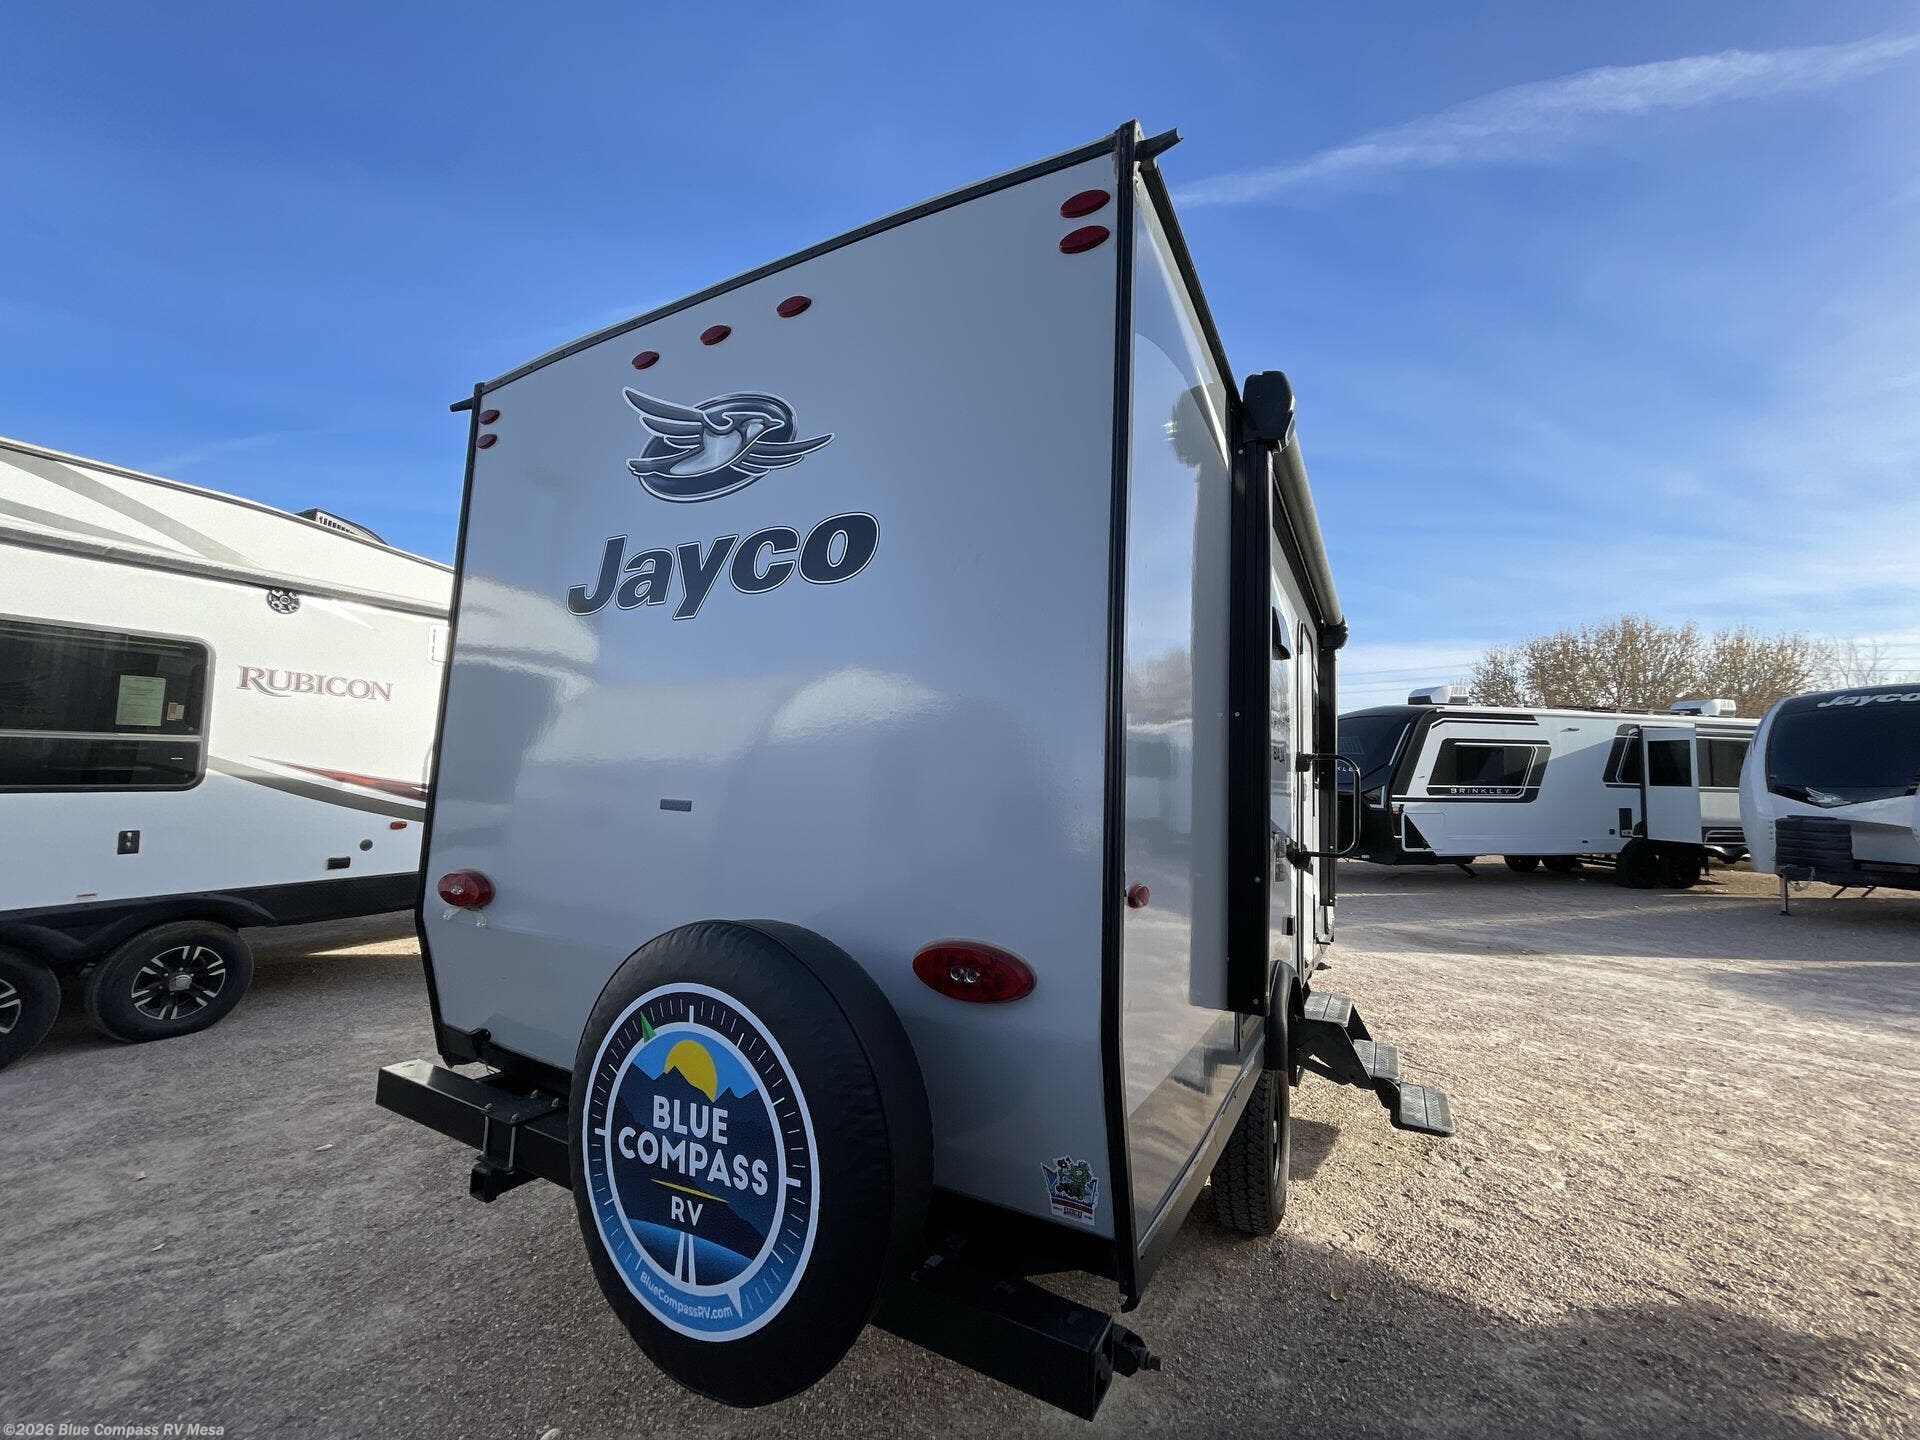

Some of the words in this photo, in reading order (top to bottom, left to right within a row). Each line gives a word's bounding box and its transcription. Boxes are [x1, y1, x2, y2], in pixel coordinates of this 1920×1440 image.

[566, 511, 880, 621] Jayco
[237, 665, 394, 702] RUBICON
[1817, 692, 1920, 708] Jayco
[652, 1095, 729, 1145] BLUE
[618, 1126, 769, 1196] COMPASS
[671, 1196, 704, 1226] RV
[640, 1272, 733, 1320] BlueCompassRV.com
